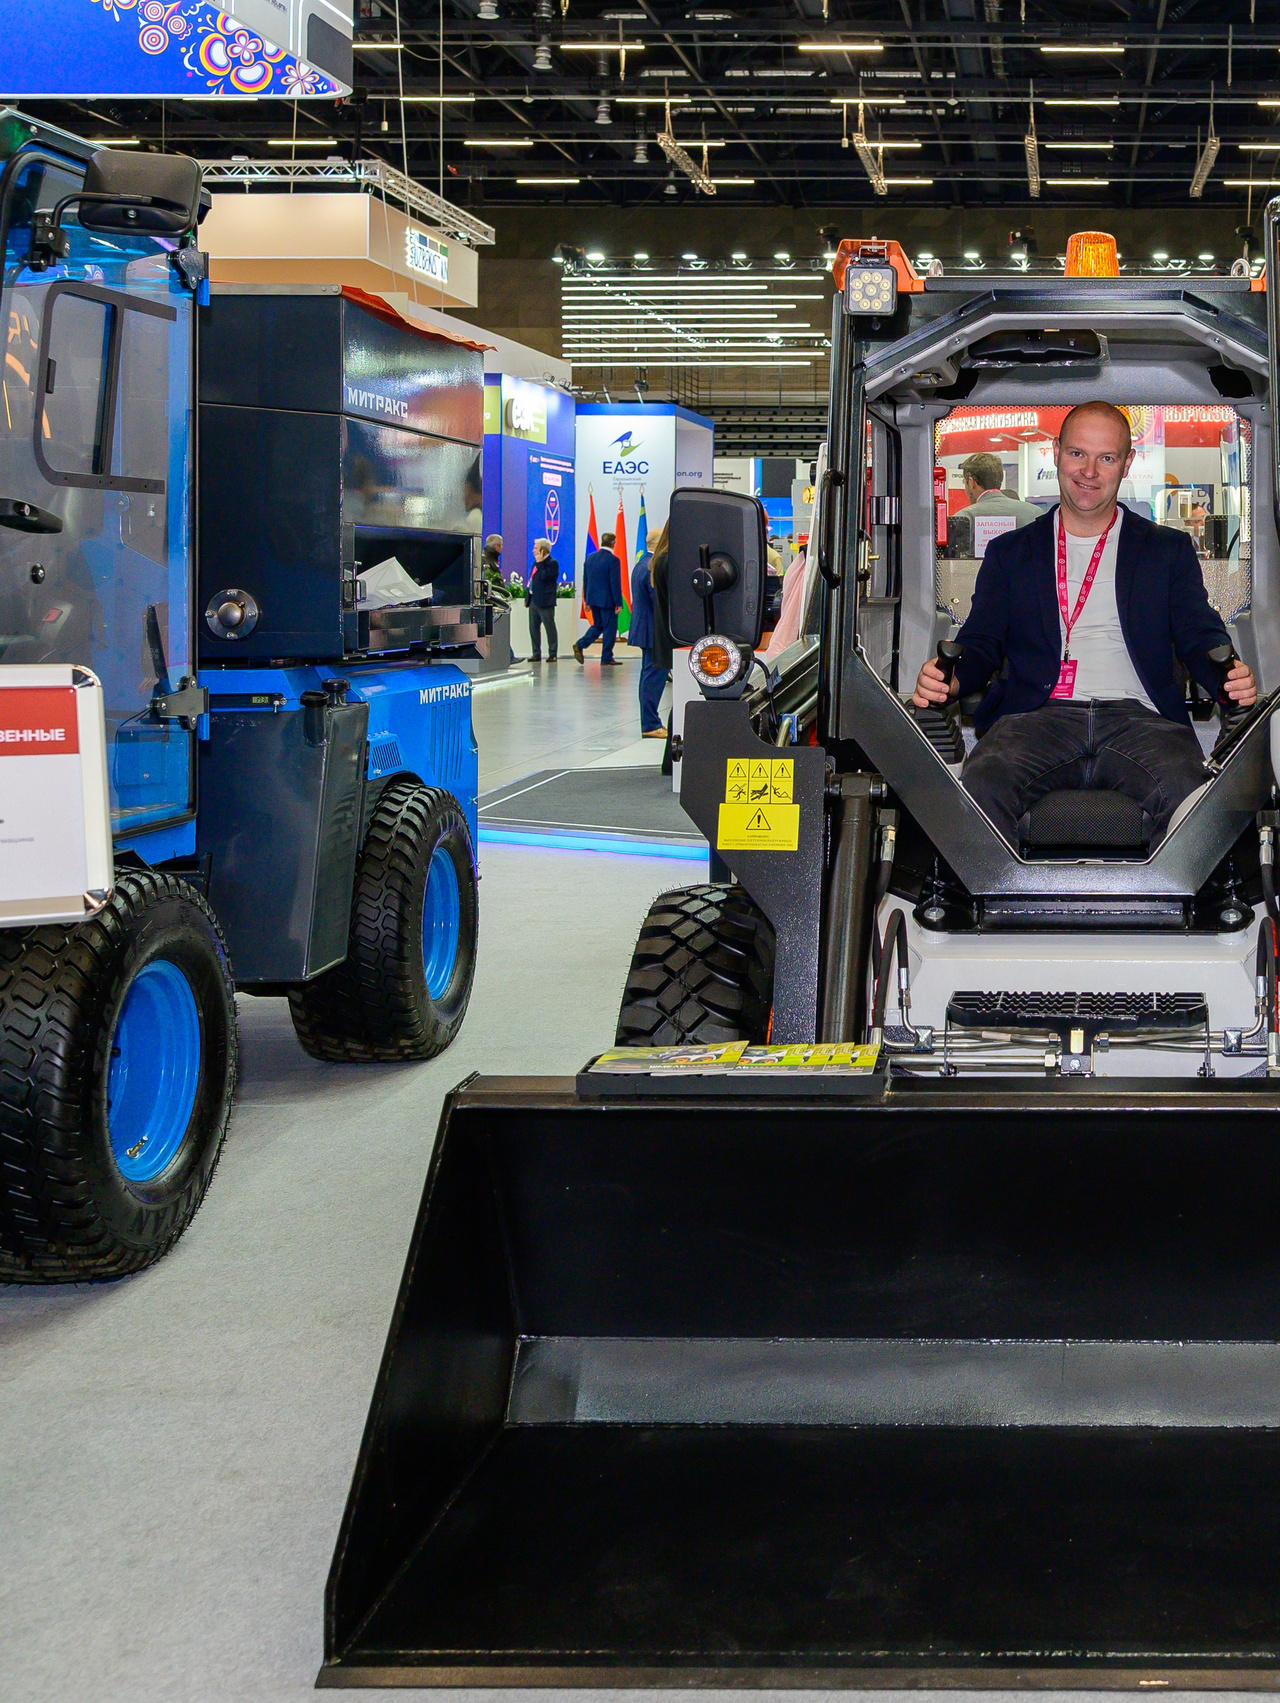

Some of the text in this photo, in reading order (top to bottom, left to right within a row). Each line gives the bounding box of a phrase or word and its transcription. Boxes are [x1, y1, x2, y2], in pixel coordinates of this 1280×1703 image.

[347, 386, 408, 419] МИТРАКС
[602, 461, 650, 475] ЕАЭС
[419, 682, 470, 705] МИТРАКС
